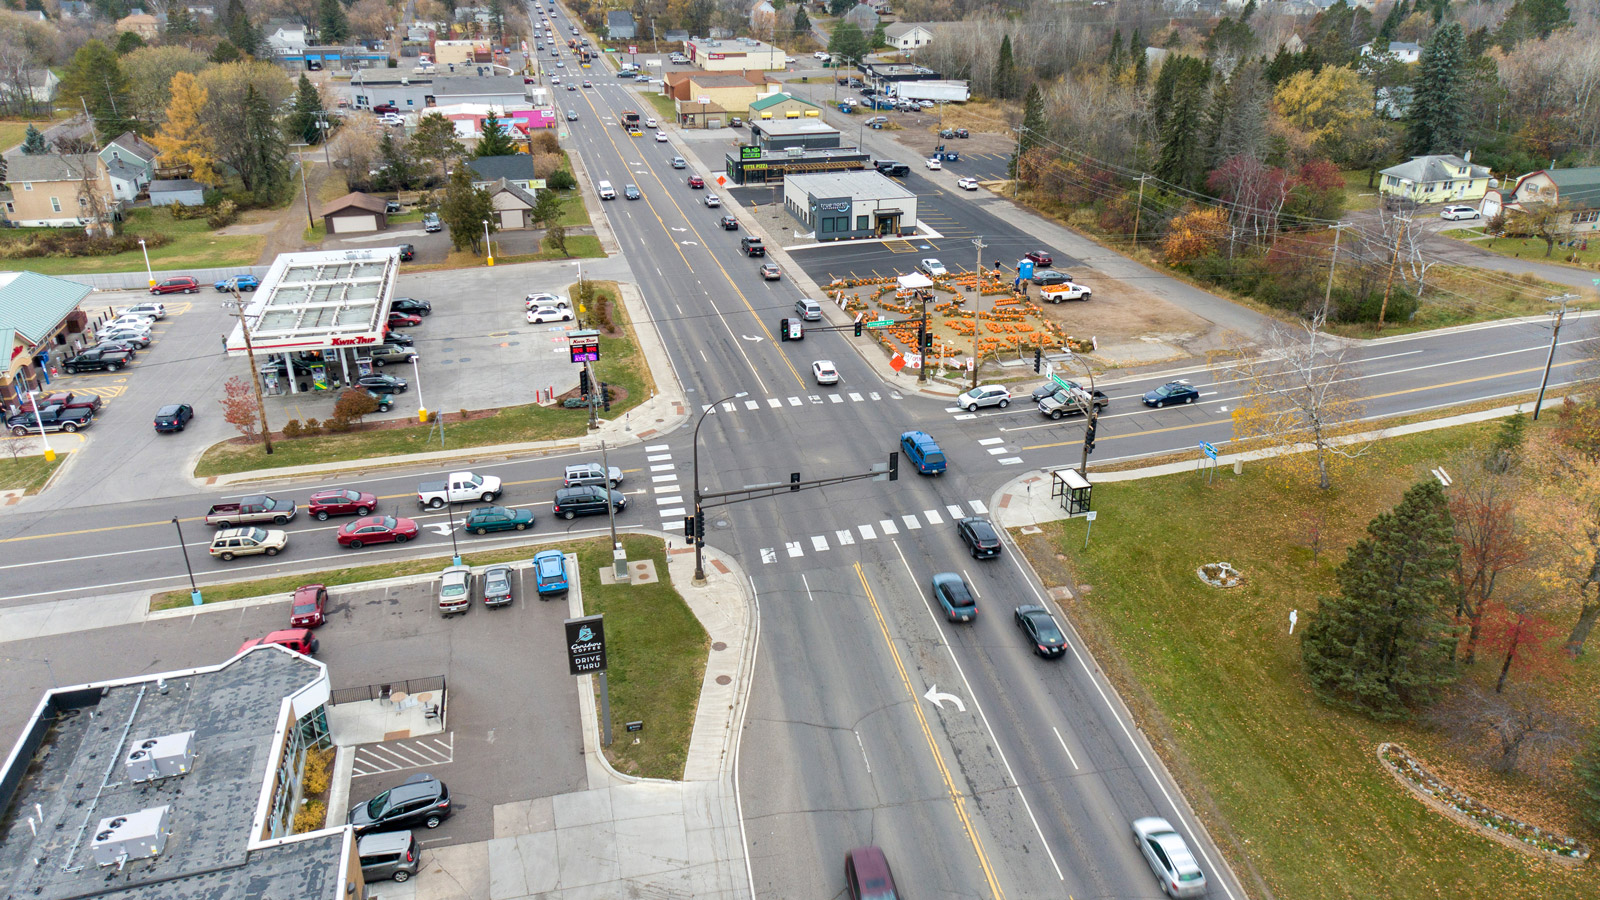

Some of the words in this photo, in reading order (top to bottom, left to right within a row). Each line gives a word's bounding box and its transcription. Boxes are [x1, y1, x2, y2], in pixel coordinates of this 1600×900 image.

[355, 336, 376, 344] TRIP
[571, 642, 602, 650] Caribou
[575, 654, 601, 664] DRIVE
[577, 662, 600, 670] THRU
